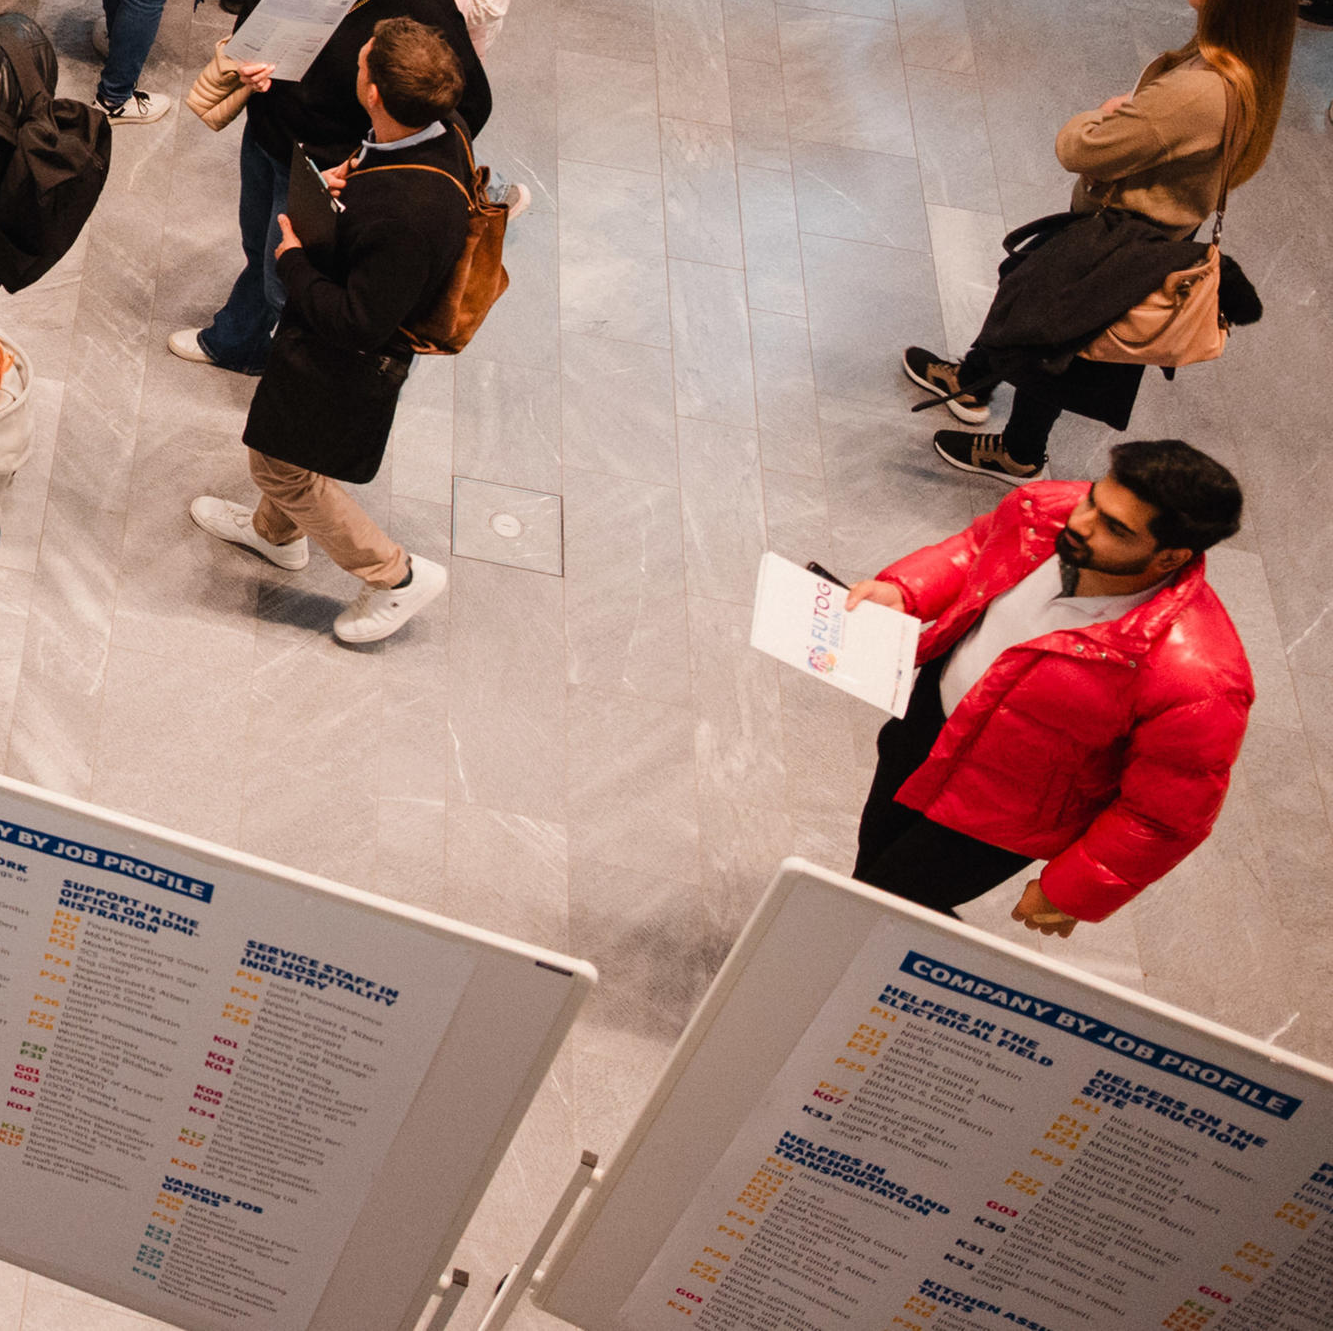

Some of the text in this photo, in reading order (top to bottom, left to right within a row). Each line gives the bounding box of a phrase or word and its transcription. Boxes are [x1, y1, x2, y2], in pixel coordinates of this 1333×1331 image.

[811, 582, 833, 642] FUTOG
[18, 830, 51, 849] BY
[53, 843, 99, 864] JOB
[103, 854, 205, 898] PROFILE
[58, 898, 159, 934] NISTRATION
[60, 889, 120, 912] OFFICE
[123, 907, 146, 920] OR
[62, 879, 200, 928] SUPPORT IN THE
[240, 957, 329, 991] INDUSTRY
[244, 948, 397, 1007] THE HOSPITALITY
[247, 940, 399, 999] SERVICE STAFF IN
[878, 993, 1054, 1067] ELECTRICAL FIELD
[883, 984, 1041, 1050] HELPERS IN THE
[911, 959, 1288, 1114] COMPANY BY JOB PROFILE
[1080, 1086, 1128, 1110] SITE
[1088, 1077, 1249, 1152] CONSTRUCTION
[1095, 1069, 1269, 1148] HELPERS ON THE
[778, 1138, 951, 1216] WAREHOUSING AND
[783, 1130, 886, 1176] HELPERS IN
[161, 1182, 221, 1208] OFFERS
[164, 1175, 264, 1215] VARIOUS JOB
[773, 1145, 931, 1217] TRANSPORTATION
[973, 1216, 1006, 1234] K30
[919, 1285, 975, 1314] TANTS
[922, 1278, 1002, 1315] KITCHEN
